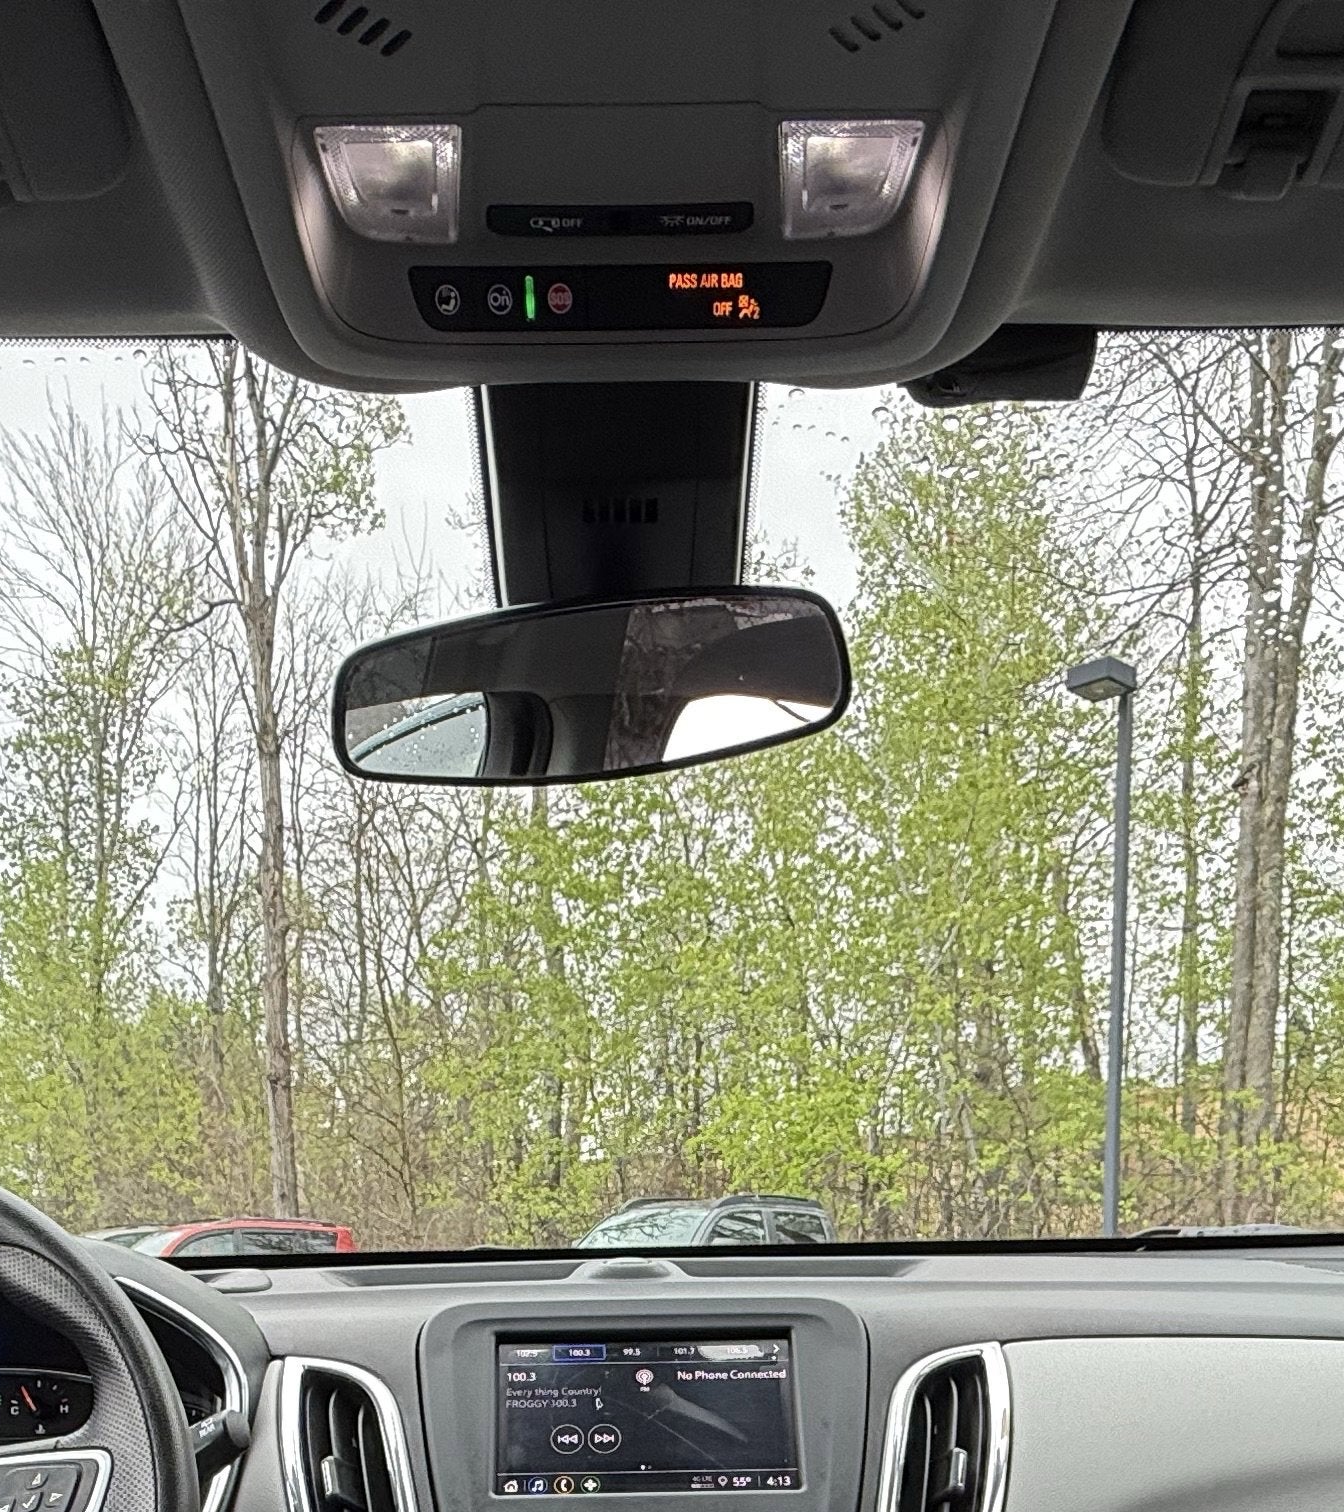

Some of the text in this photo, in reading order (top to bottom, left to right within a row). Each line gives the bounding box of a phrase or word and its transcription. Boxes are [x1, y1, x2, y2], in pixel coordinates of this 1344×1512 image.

[560, 218, 584, 228] OFF
[686, 215, 733, 227] ON/OFF
[668, 273, 743, 289] PASS AIR BAG
[712, 301, 733, 316] OFF
[506, 1371, 537, 1382] 100.3
[677, 1369, 787, 1380] No Phone Connected
[506, 1387, 531, 1398] Every
[535, 1387, 559, 1398] thing
[60, 1404, 69, 1414] H
[506, 1399, 548, 1409] FROGGY
[11, 1406, 19, 1416] C
[766, 1475, 792, 1487] 4:13
